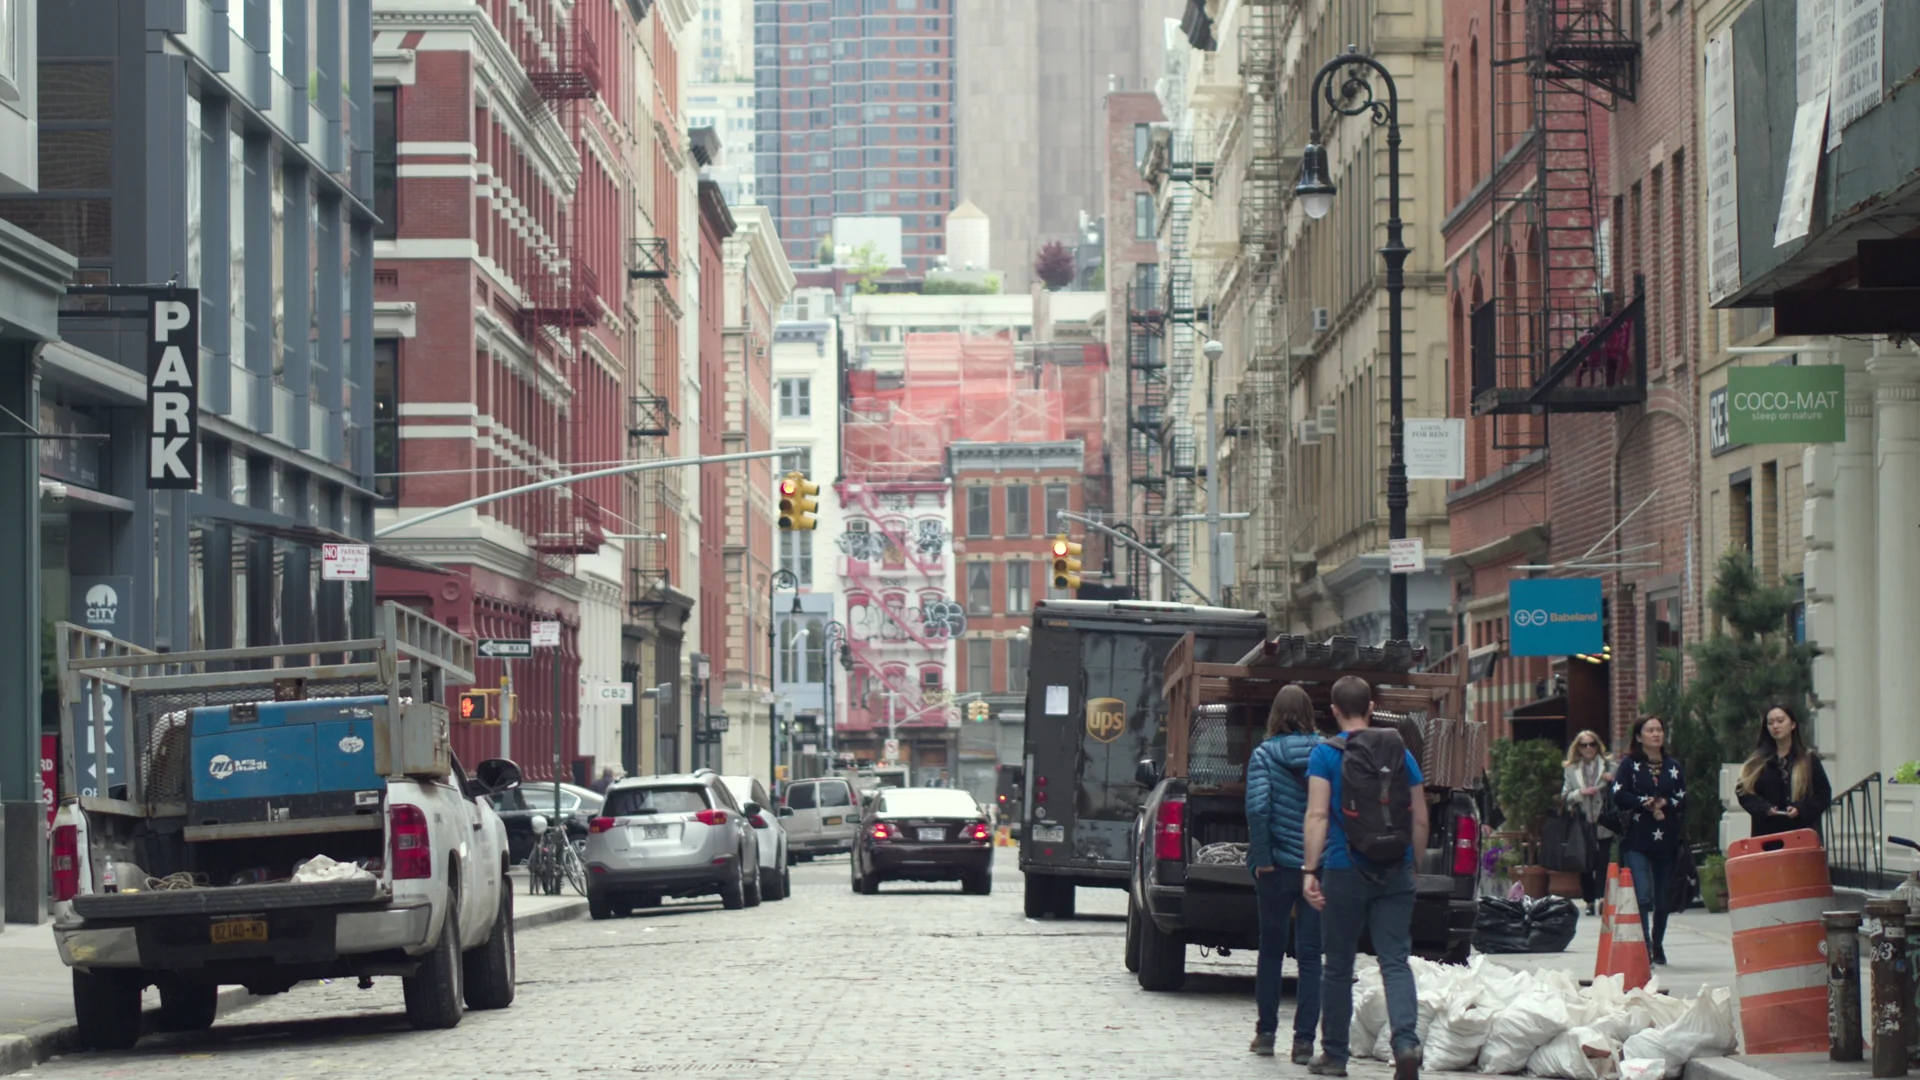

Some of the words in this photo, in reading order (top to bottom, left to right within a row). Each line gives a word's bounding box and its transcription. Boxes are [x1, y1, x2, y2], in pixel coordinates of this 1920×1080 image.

[152, 301, 193, 478] PARK
[1734, 391, 1839, 410] COCO-MAT
[1711, 391, 1728, 449] RE
[1752, 412, 1777, 422] sleep
[1778, 412, 1791, 420] on
[1792, 411, 1823, 420] nature
[325, 546, 337, 558] NO
[86, 608, 117, 618] CITY
[1550, 613, 1597, 621] Babeland
[602, 688, 626, 698] CB2
[1089, 712, 1123, 735] ups
